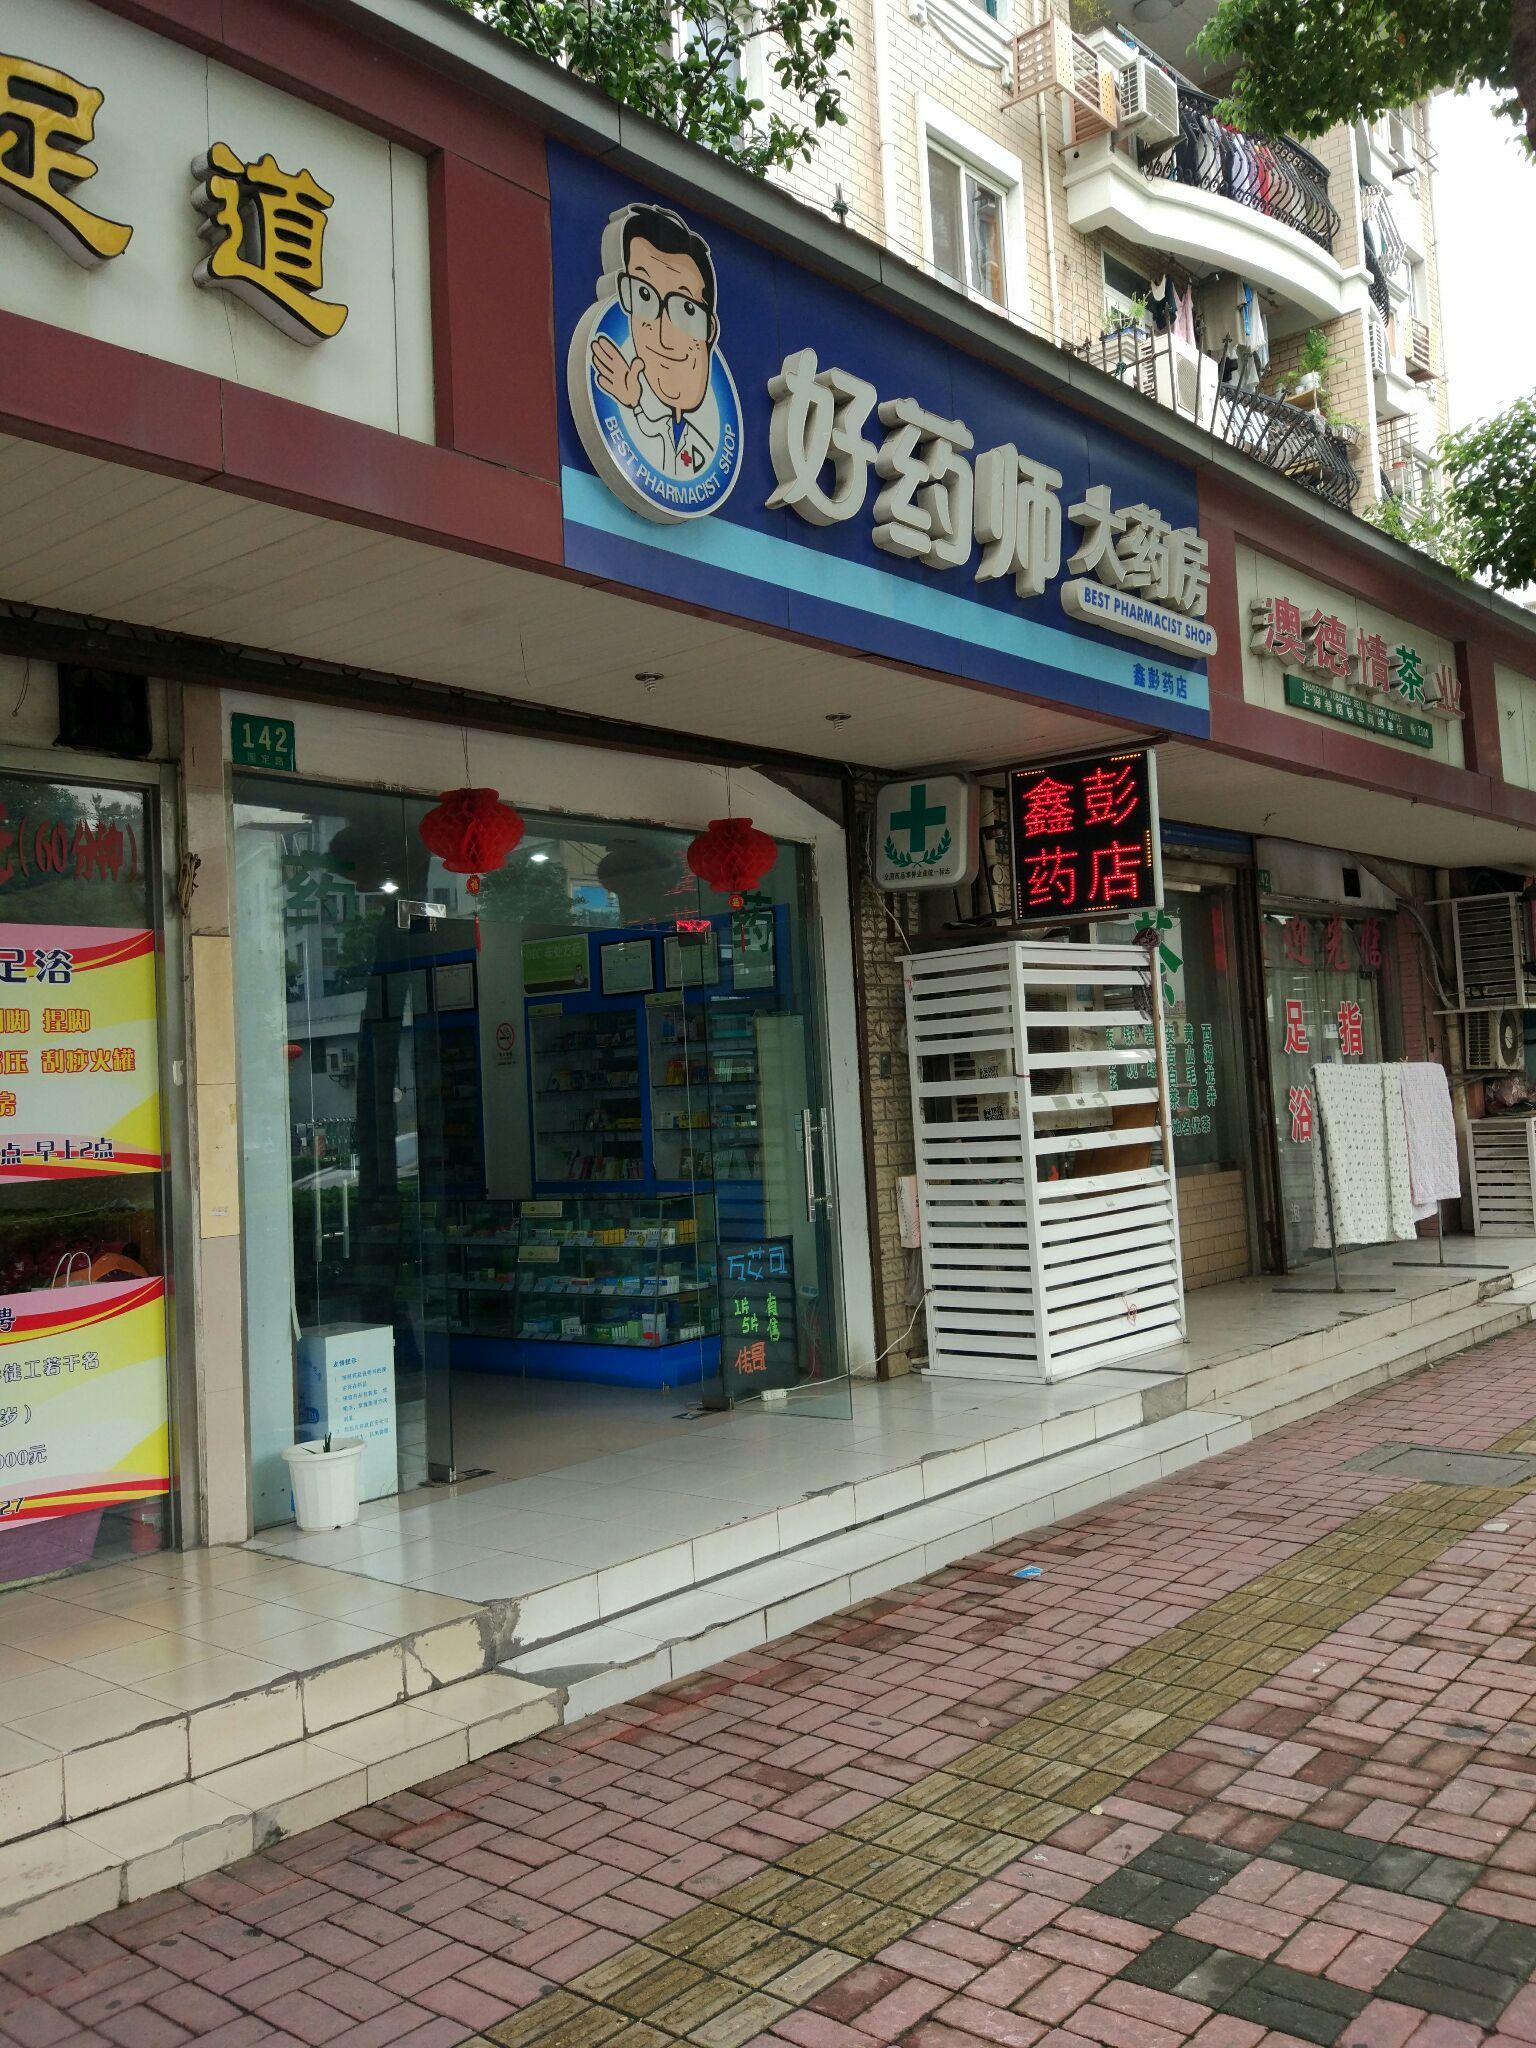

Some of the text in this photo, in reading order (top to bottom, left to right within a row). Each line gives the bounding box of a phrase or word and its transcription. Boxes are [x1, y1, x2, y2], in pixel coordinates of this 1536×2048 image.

[604, 415, 736, 505] BEST PHARMACIST SHOP
[765, 346, 1211, 617] 好药师 大药房
[1084, 586, 1213, 647] BEST PHARMACIST SHOP
[1132, 661, 1189, 700] 鑫彭药店
[1252, 596, 1466, 721] 澳德情茶业
[242, 722, 288, 753] 142
[1022, 765, 1140, 838] 鑫彭
[1024, 839, 1143, 906] 药店
[0, 948, 73, 984] 足浴
[0, 1007, 91, 1034] 脚 捏脚
[1337, 1000, 1364, 1056] 指
[41, 1047, 136, 1074] 刮痧火罐
[1183, 1023, 1200, 1111] 黄山毛峰
[1201, 1023, 1218, 1108] 西湖龙井
[0, 1351, 100, 1384] 徒工若干名
